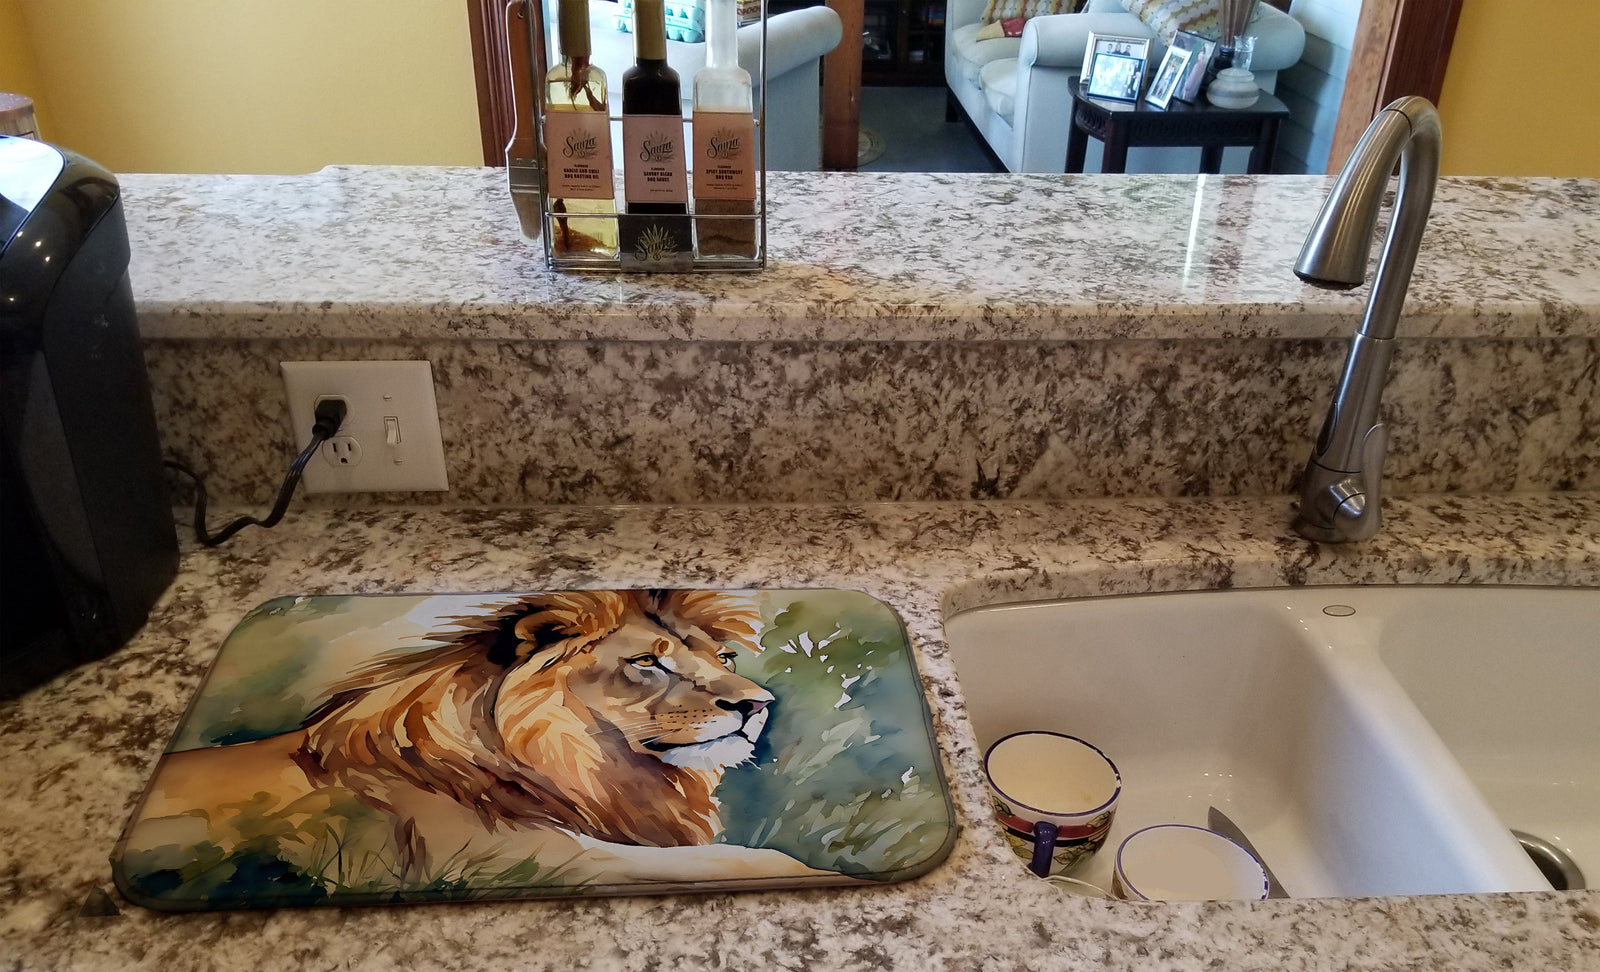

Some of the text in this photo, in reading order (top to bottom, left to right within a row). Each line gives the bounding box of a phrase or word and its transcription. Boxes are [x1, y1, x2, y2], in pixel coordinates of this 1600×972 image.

[563, 136, 597, 158] Sauza
[640, 140, 673, 161] Sauza
[706, 136, 740, 158] Sauza
